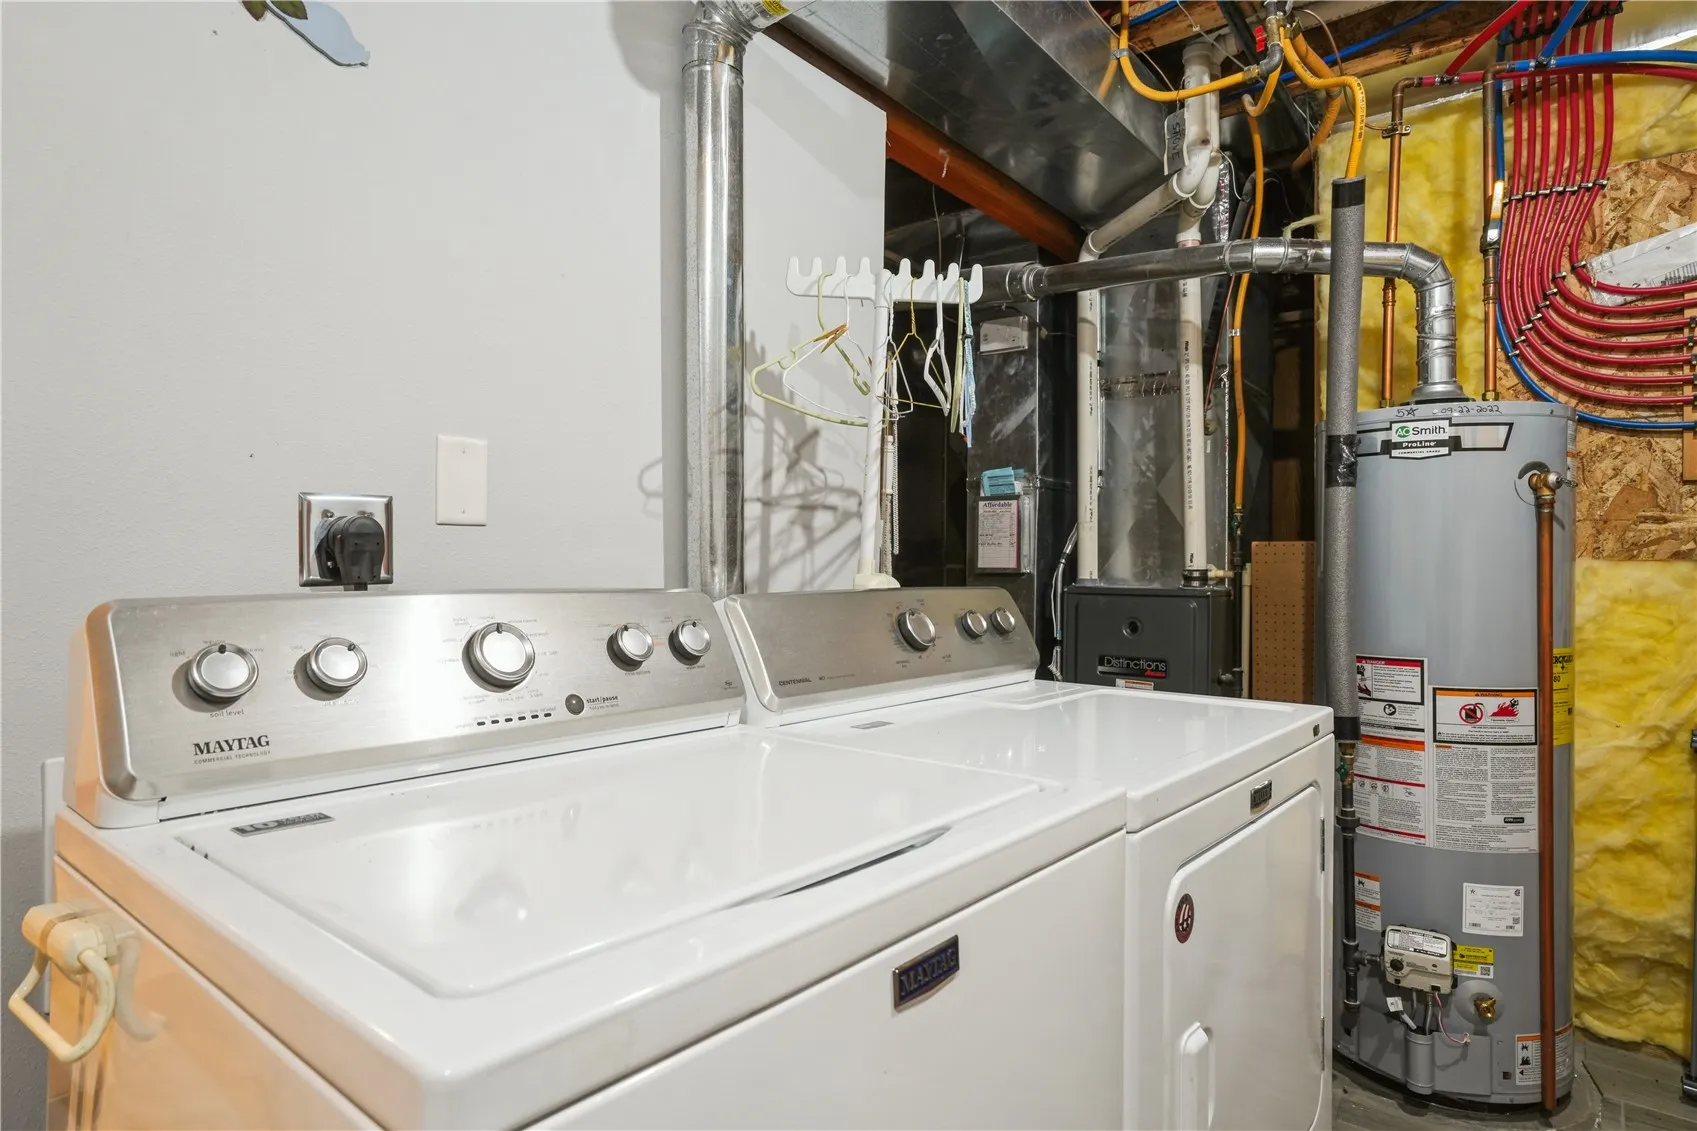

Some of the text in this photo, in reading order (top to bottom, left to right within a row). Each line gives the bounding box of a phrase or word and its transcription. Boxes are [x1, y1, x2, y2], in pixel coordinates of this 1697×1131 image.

[1171, 122, 1182, 161] STOVE
[1440, 404, 1503, 415] 09-22-2022
[1412, 425, 1446, 436] Smith
[1104, 656, 1167, 671] Distinctions
[778, 677, 812, 687] CENTENNIAL
[586, 694, 619, 704] start/pause
[209, 708, 245, 719] soil level
[192, 734, 270, 757] MAYTAG
[194, 749, 272, 765] COMMERCIAL TECHNOLOGY
